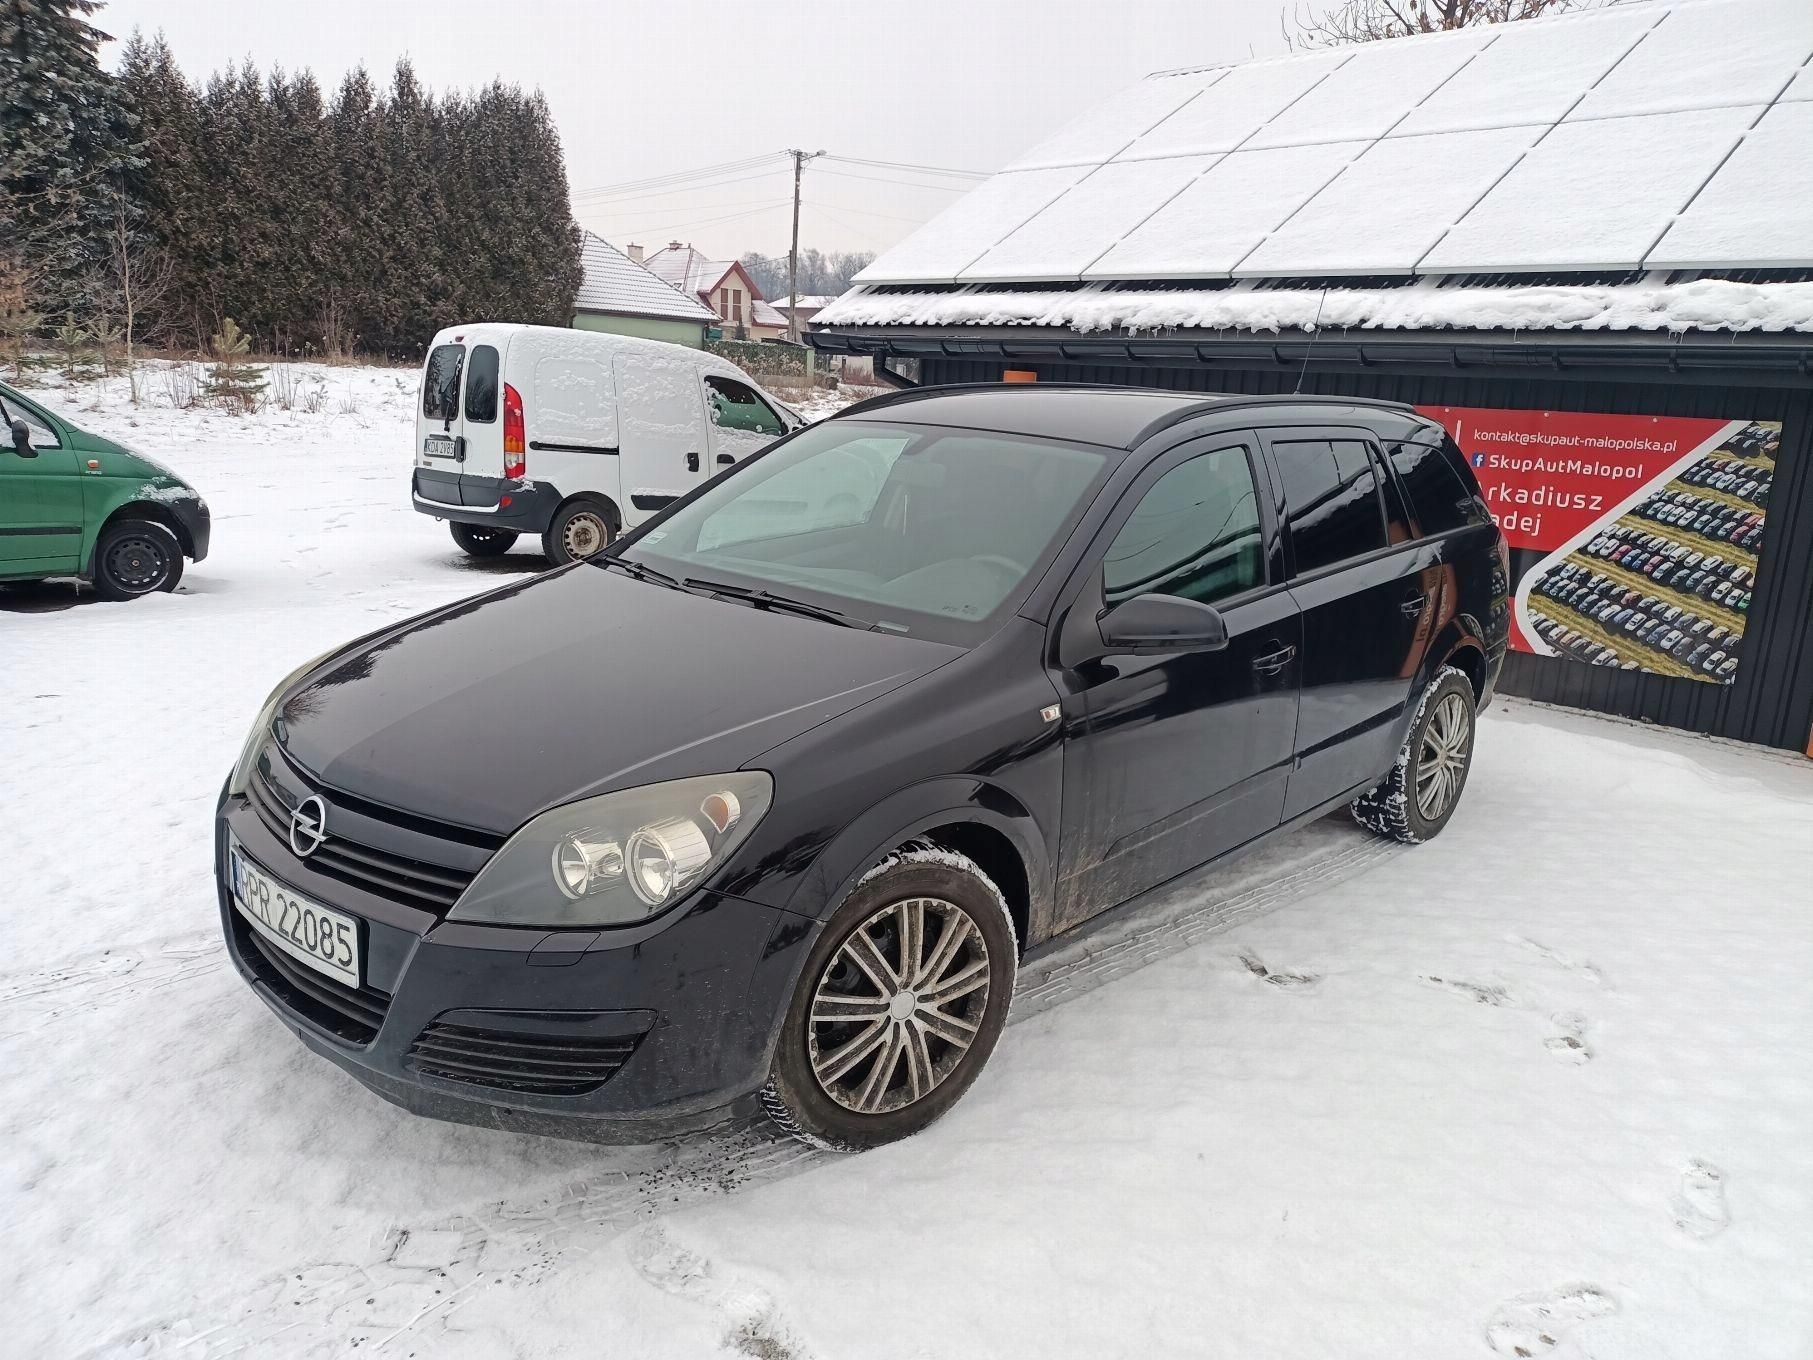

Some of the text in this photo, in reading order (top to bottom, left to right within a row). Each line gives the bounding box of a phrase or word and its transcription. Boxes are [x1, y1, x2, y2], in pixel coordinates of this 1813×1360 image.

[1474, 429, 1678, 453] kontakt@skupaut-malopolska.pl
[1488, 454, 1644, 480] SkupAutMalopol
[1478, 480, 1604, 512] rkadiusz
[1490, 510, 1542, 537] adej
[276, 893, 353, 968] 22085
